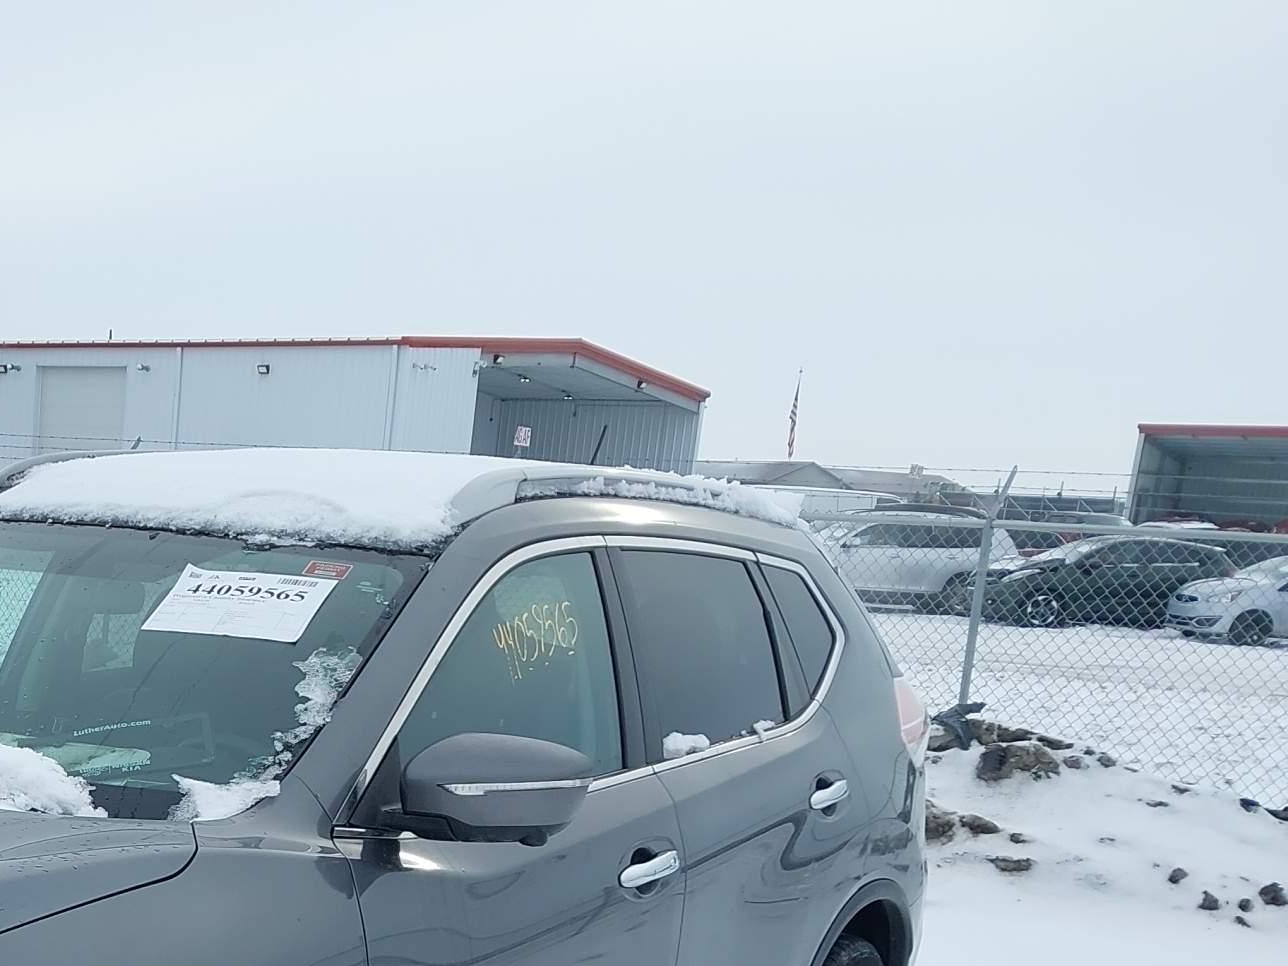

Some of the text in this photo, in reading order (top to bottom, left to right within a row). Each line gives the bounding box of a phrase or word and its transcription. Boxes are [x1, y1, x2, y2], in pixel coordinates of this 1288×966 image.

[186, 582, 309, 602] 44059565
[492, 601, 579, 680] 44059565
[73, 719, 151, 737] LutherAuto.com
